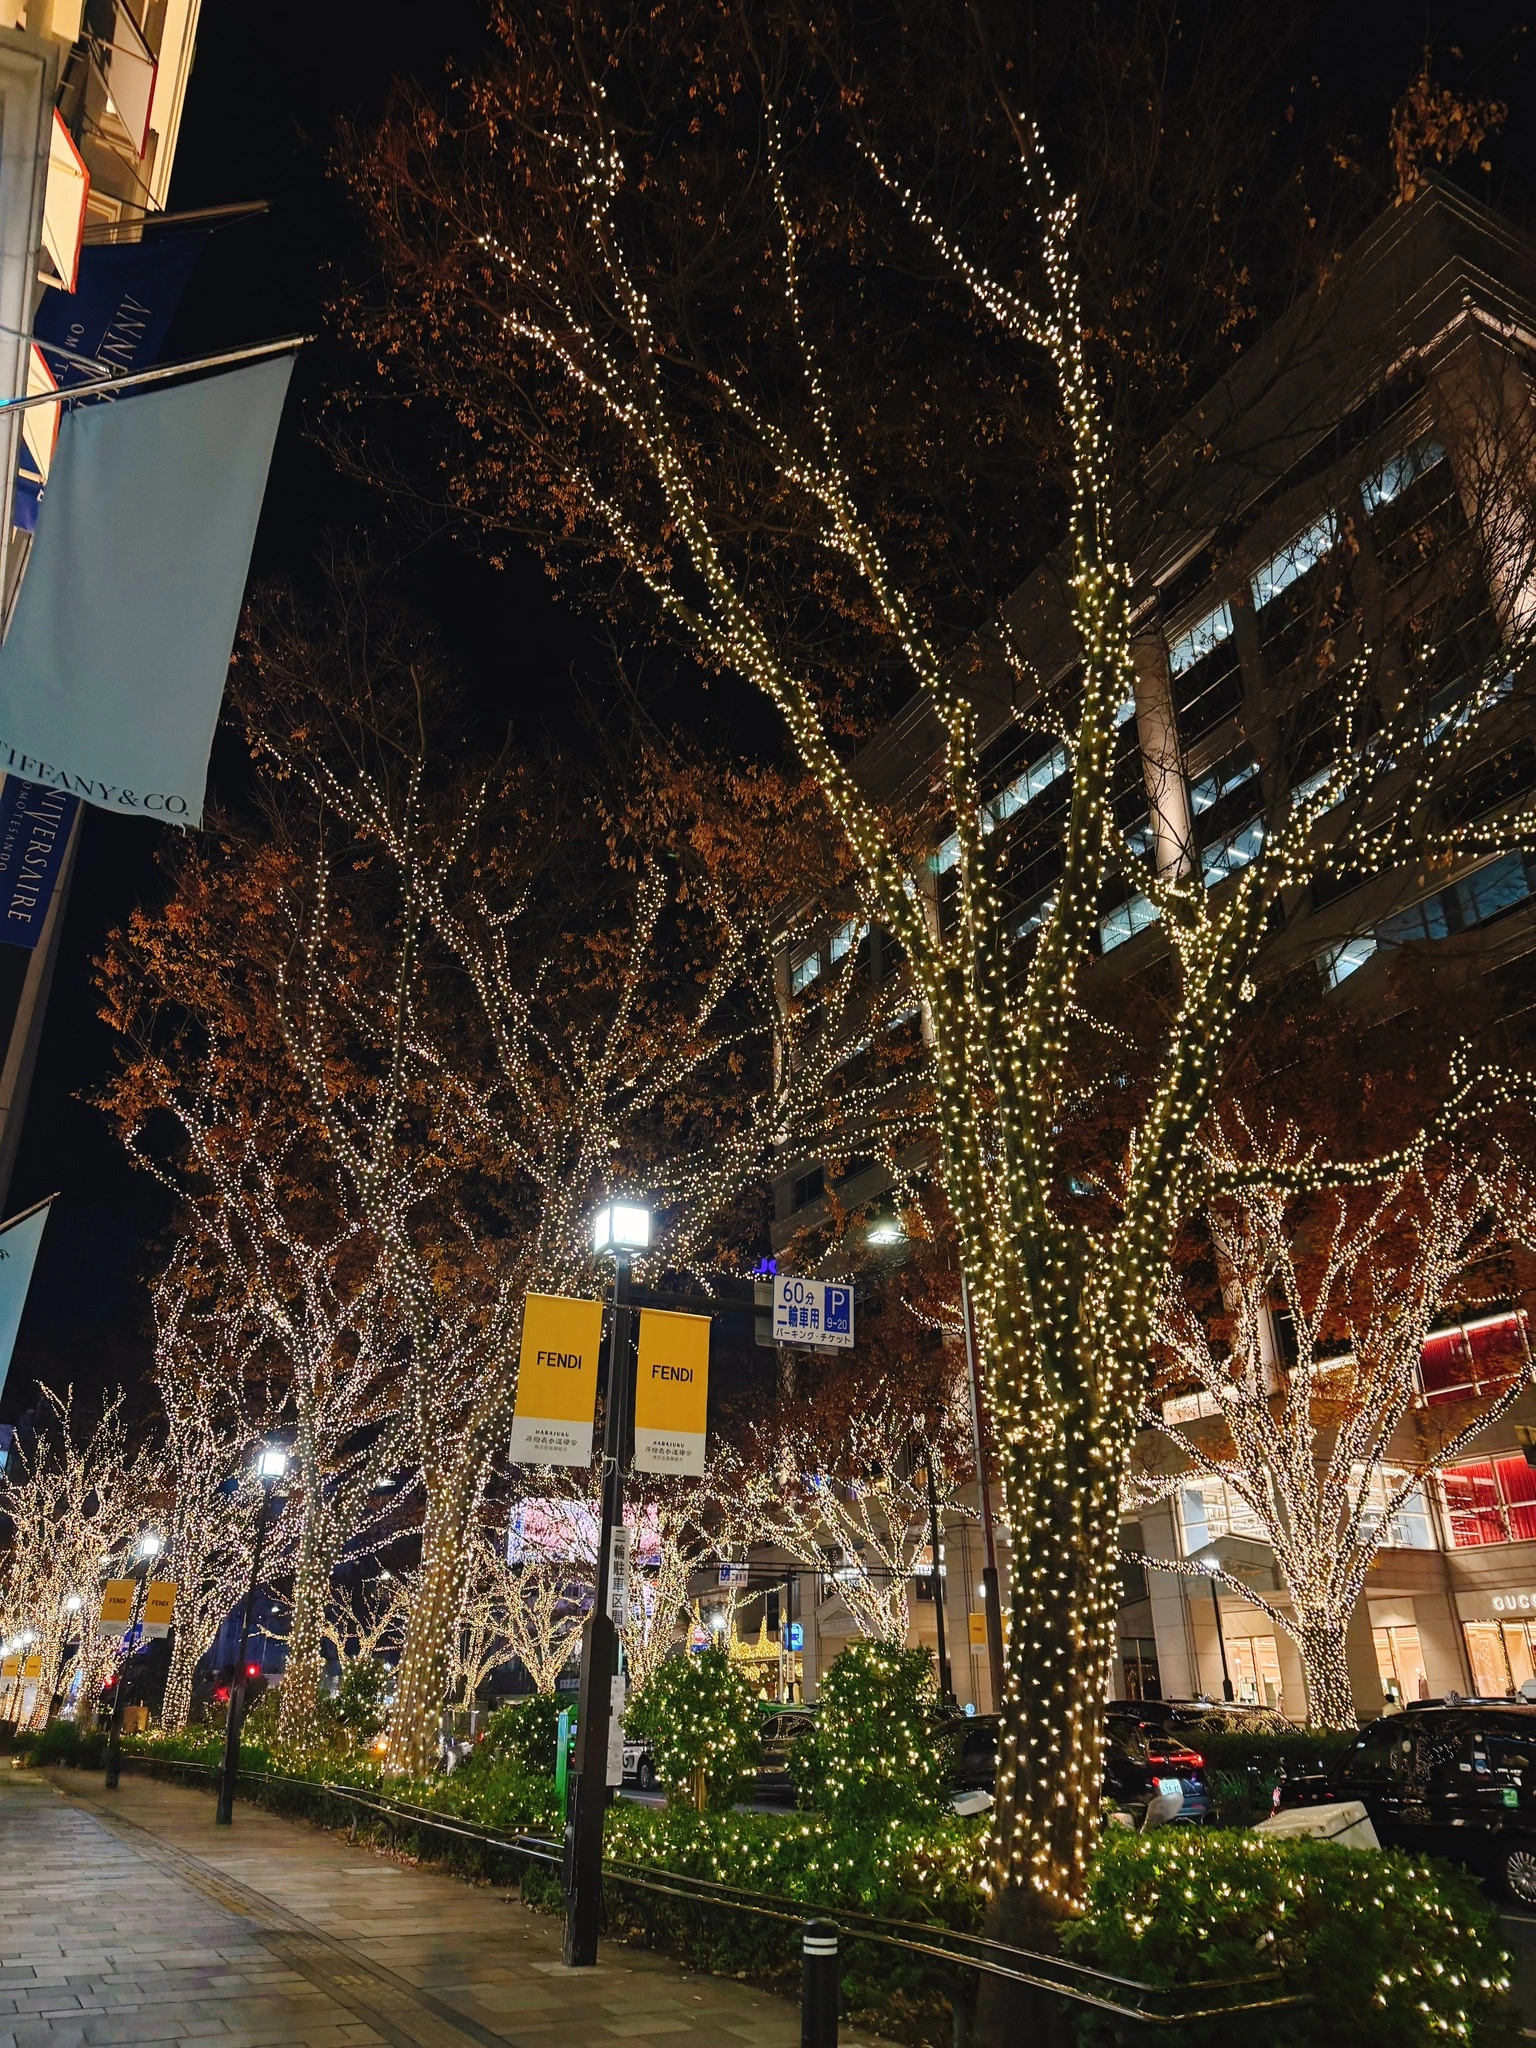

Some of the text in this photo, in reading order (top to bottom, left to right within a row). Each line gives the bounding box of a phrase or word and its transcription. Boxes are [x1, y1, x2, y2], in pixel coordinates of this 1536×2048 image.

[0, 781, 33, 871] OMOTESANDO
[783, 1281, 815, 1305] 60分
[831, 1290, 845, 1315] P
[777, 1304, 820, 1330] 二輪車用
[826, 1317, 848, 1330] 9-20
[537, 1350, 582, 1370] FENDI
[651, 1364, 694, 1383] FENDI
[535, 1429, 570, 1438] HARAJUKU
[652, 1440, 685, 1448] HARAJUKU
[611, 1529, 626, 1626] 二輪駐車区間
[151, 1599, 169, 1607] FENDI
